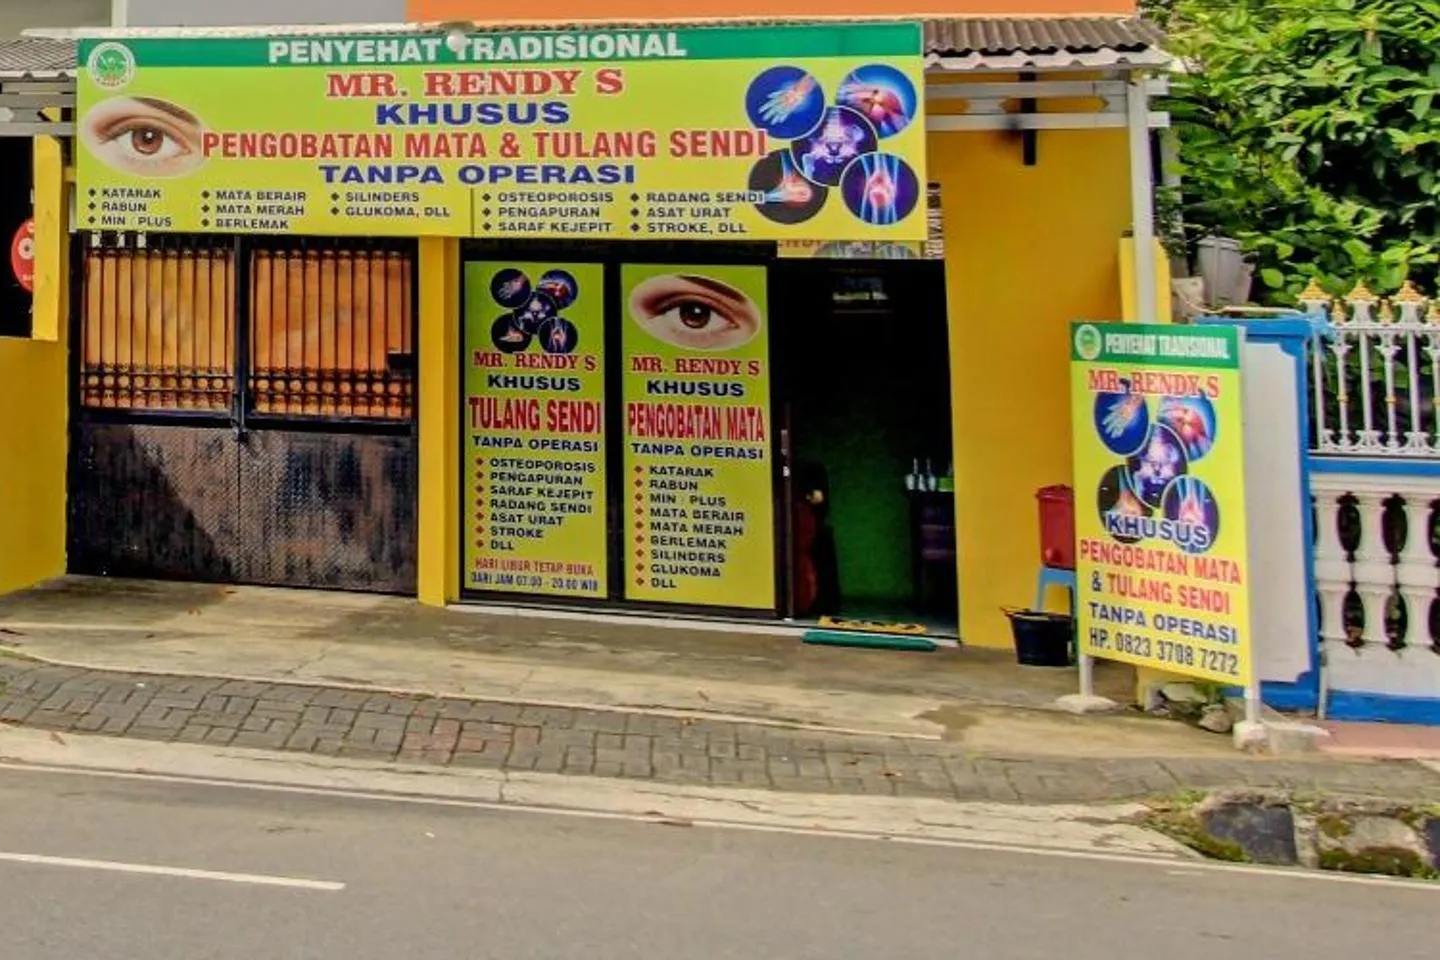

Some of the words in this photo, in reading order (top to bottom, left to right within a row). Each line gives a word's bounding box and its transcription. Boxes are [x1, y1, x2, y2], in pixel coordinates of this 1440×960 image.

[268, 38, 442, 64] PENYEHAT
[453, 32, 687, 61] TRADISIONAL
[327, 73, 407, 97] MR.
[424, 70, 582, 96] RENDY
[595, 69, 623, 95] S
[377, 102, 569, 126] KHUSUS
[203, 132, 392, 158] PENGOBATAN
[405, 132, 487, 158] MATA
[499, 132, 520, 158] &
[533, 131, 656, 158] TULANG
[670, 130, 766, 157] SENDI
[319, 166, 444, 184] TANPA
[458, 165, 635, 184] OPERASI
[101, 189, 161, 199] KATARAK
[216, 191, 252, 201] MATA
[257, 192, 306, 202] BERAIR
[345, 192, 420, 203] SILINDERS
[497, 192, 614, 203] OSTEOPOROSIS
[646, 192, 710, 203] RADANG
[716, 192, 764, 203] SENDI
[101, 202, 147, 212] RABUN
[216, 205, 252, 215] MATA
[257, 205, 305, 216] MERAH
[345, 207, 419, 218] GLUKOMA,
[424, 207, 450, 218] DLL
[498, 207, 600, 218] PENGAPURAN
[646, 207, 685, 218] ASAT
[690, 207, 732, 218] URAT
[101, 216, 126, 226] MIN
[138, 217, 172, 227] PLUS
[216, 219, 288, 230] BERLEMAK
[498, 222, 544, 232] SARAF
[551, 222, 611, 233] KEJEPIT
[647, 222, 713, 234] STROKE,
[718, 222, 747, 233] DLL
[474, 351, 507, 368] MR.
[515, 352, 578, 369] RENDY
[584, 355, 596, 371] S
[632, 356, 667, 372] MR.
[675, 358, 741, 375] RENDY
[748, 360, 760, 376] S
[488, 375, 581, 391] KHUSUS
[647, 380, 744, 396] KHUSUS
[1131, 372, 1200, 396] RENDY
[1207, 375, 1221, 398] S
[468, 396, 540, 431] TULANG
[547, 399, 601, 434] SENDI
[628, 403, 721, 440] PENGOBATAN
[727, 407, 765, 442] MATA
[472, 436, 523, 448] TANPA
[528, 439, 598, 452] OPERASI
[632, 443, 685, 456] TANPA
[690, 446, 764, 459] OPERASI
[490, 458, 596, 472] OSTEOPOROSIS
[649, 466, 714, 477] KATARAK
[490, 472, 583, 485] PENGAPURAN
[649, 479, 698, 490] RABUN
[490, 485, 533, 496] SARAF
[537, 488, 594, 500] KEJEPIT
[490, 499, 546, 511] RADANG
[551, 503, 592, 513] SENDI
[650, 493, 677, 504] MIN
[690, 495, 727, 507] PLUS
[490, 513, 524, 523] ASAT
[529, 515, 564, 526] URAT
[650, 508, 688, 519] MATA
[693, 510, 745, 521] BERAIR
[490, 526, 544, 538] STROKE
[650, 522, 688, 533] MATA
[693, 524, 743, 536] MERAH
[1108, 514, 1210, 547] KHUSUS
[490, 540, 514, 550] DLL
[650, 535, 727, 549] BERLEMAK
[651, 549, 726, 563] SILINDERS
[1080, 539, 1188, 577] PENGOBATAN
[1194, 556, 1241, 585] MATA
[651, 564, 721, 577] GLUKOMA
[651, 578, 677, 589] DLL
[1092, 570, 1102, 592] &
[1106, 573, 1173, 605] TULANG
[1178, 584, 1231, 615] SENDI
[1089, 602, 1147, 627] TANPA
[1153, 614, 1238, 645] OPERASI
[1089, 628, 1111, 651] HP.
[1115, 632, 1152, 658] 0823
[1157, 640, 1194, 667] 3708
[1201, 649, 1240, 676] 7272
